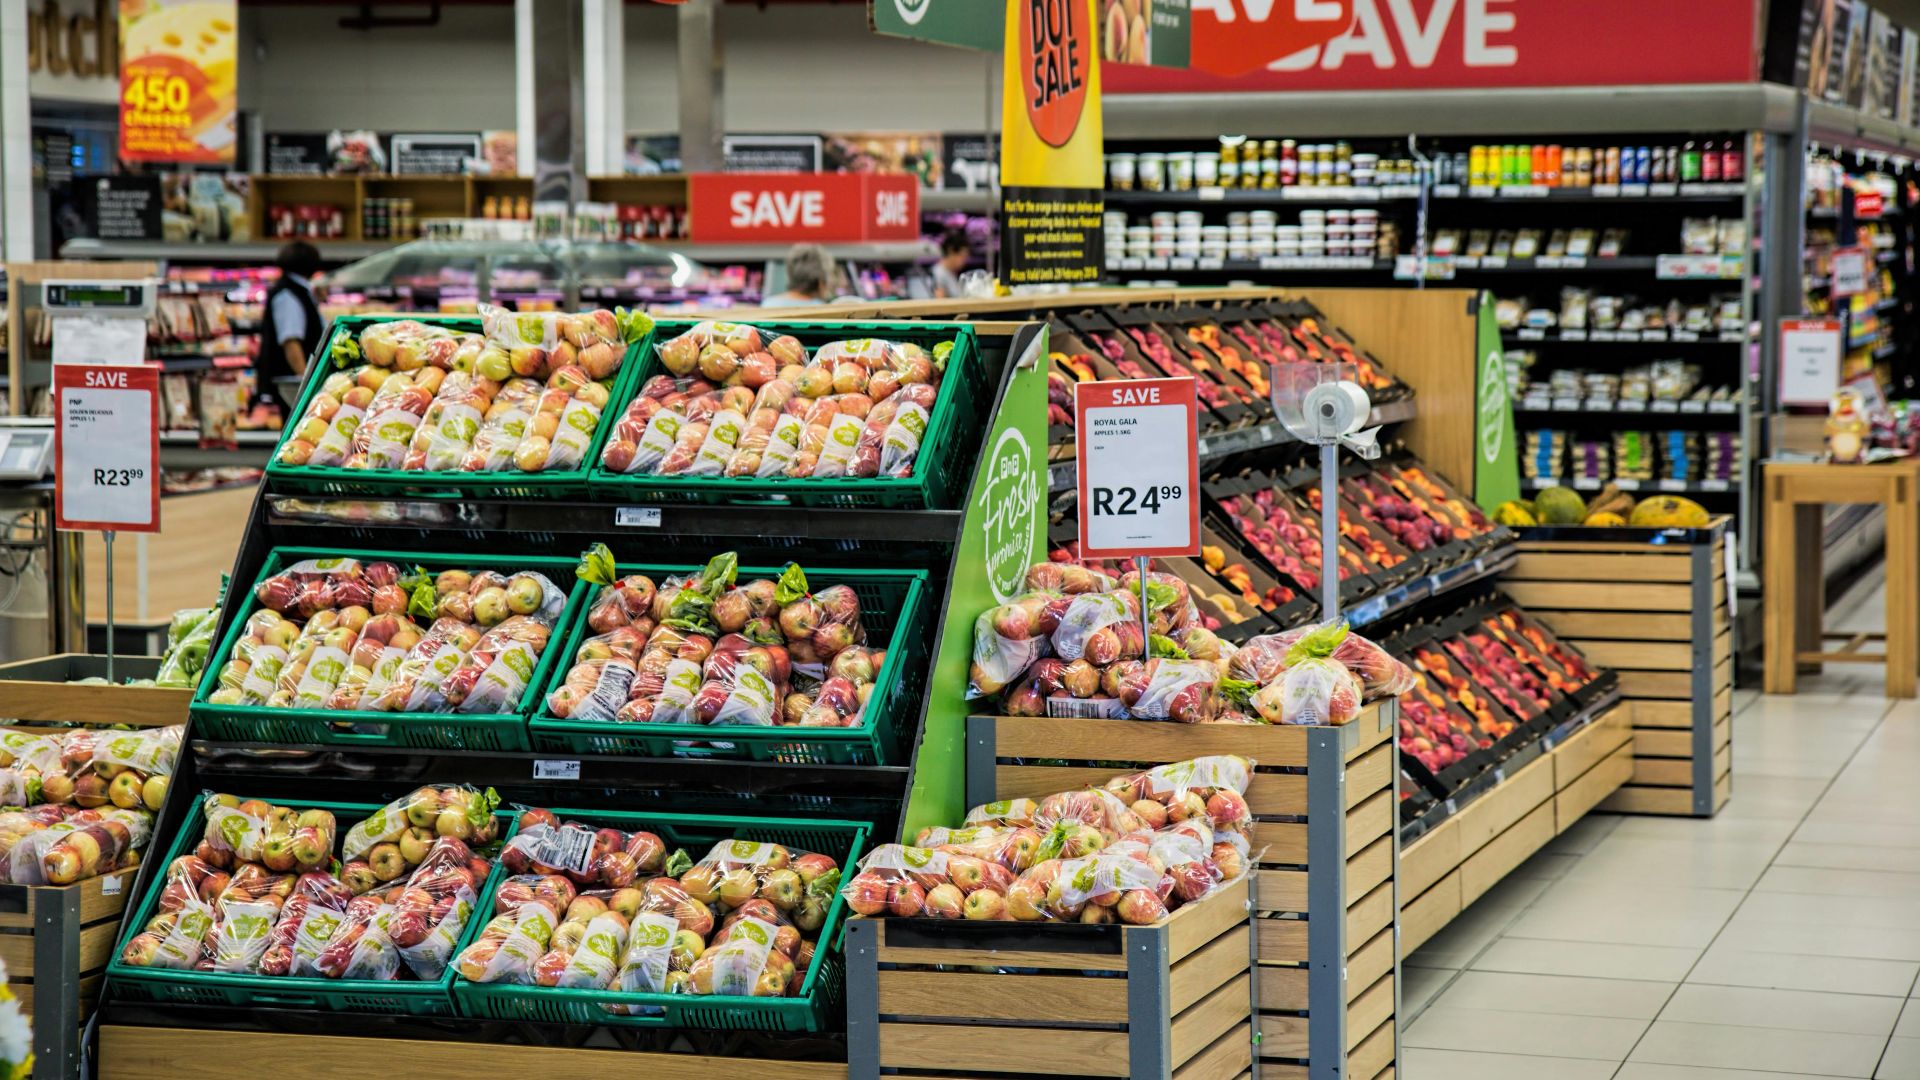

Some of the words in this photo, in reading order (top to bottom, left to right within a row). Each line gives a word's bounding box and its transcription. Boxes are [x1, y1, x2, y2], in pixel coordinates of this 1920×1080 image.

[1267, 0, 1518, 70] AVE
[1033, 38, 1081, 109] SALE
[124, 76, 191, 112] 450
[730, 190, 825, 228] SAVE
[876, 190, 909, 227] SAVE
[85, 371, 128, 387] SAVE
[1112, 387, 1160, 405] SAVE
[1094, 418, 1118, 426] ROYAL
[1118, 417, 1138, 425] GALA
[979, 446, 1041, 543] Fresh
[991, 532, 1022, 588] promise
